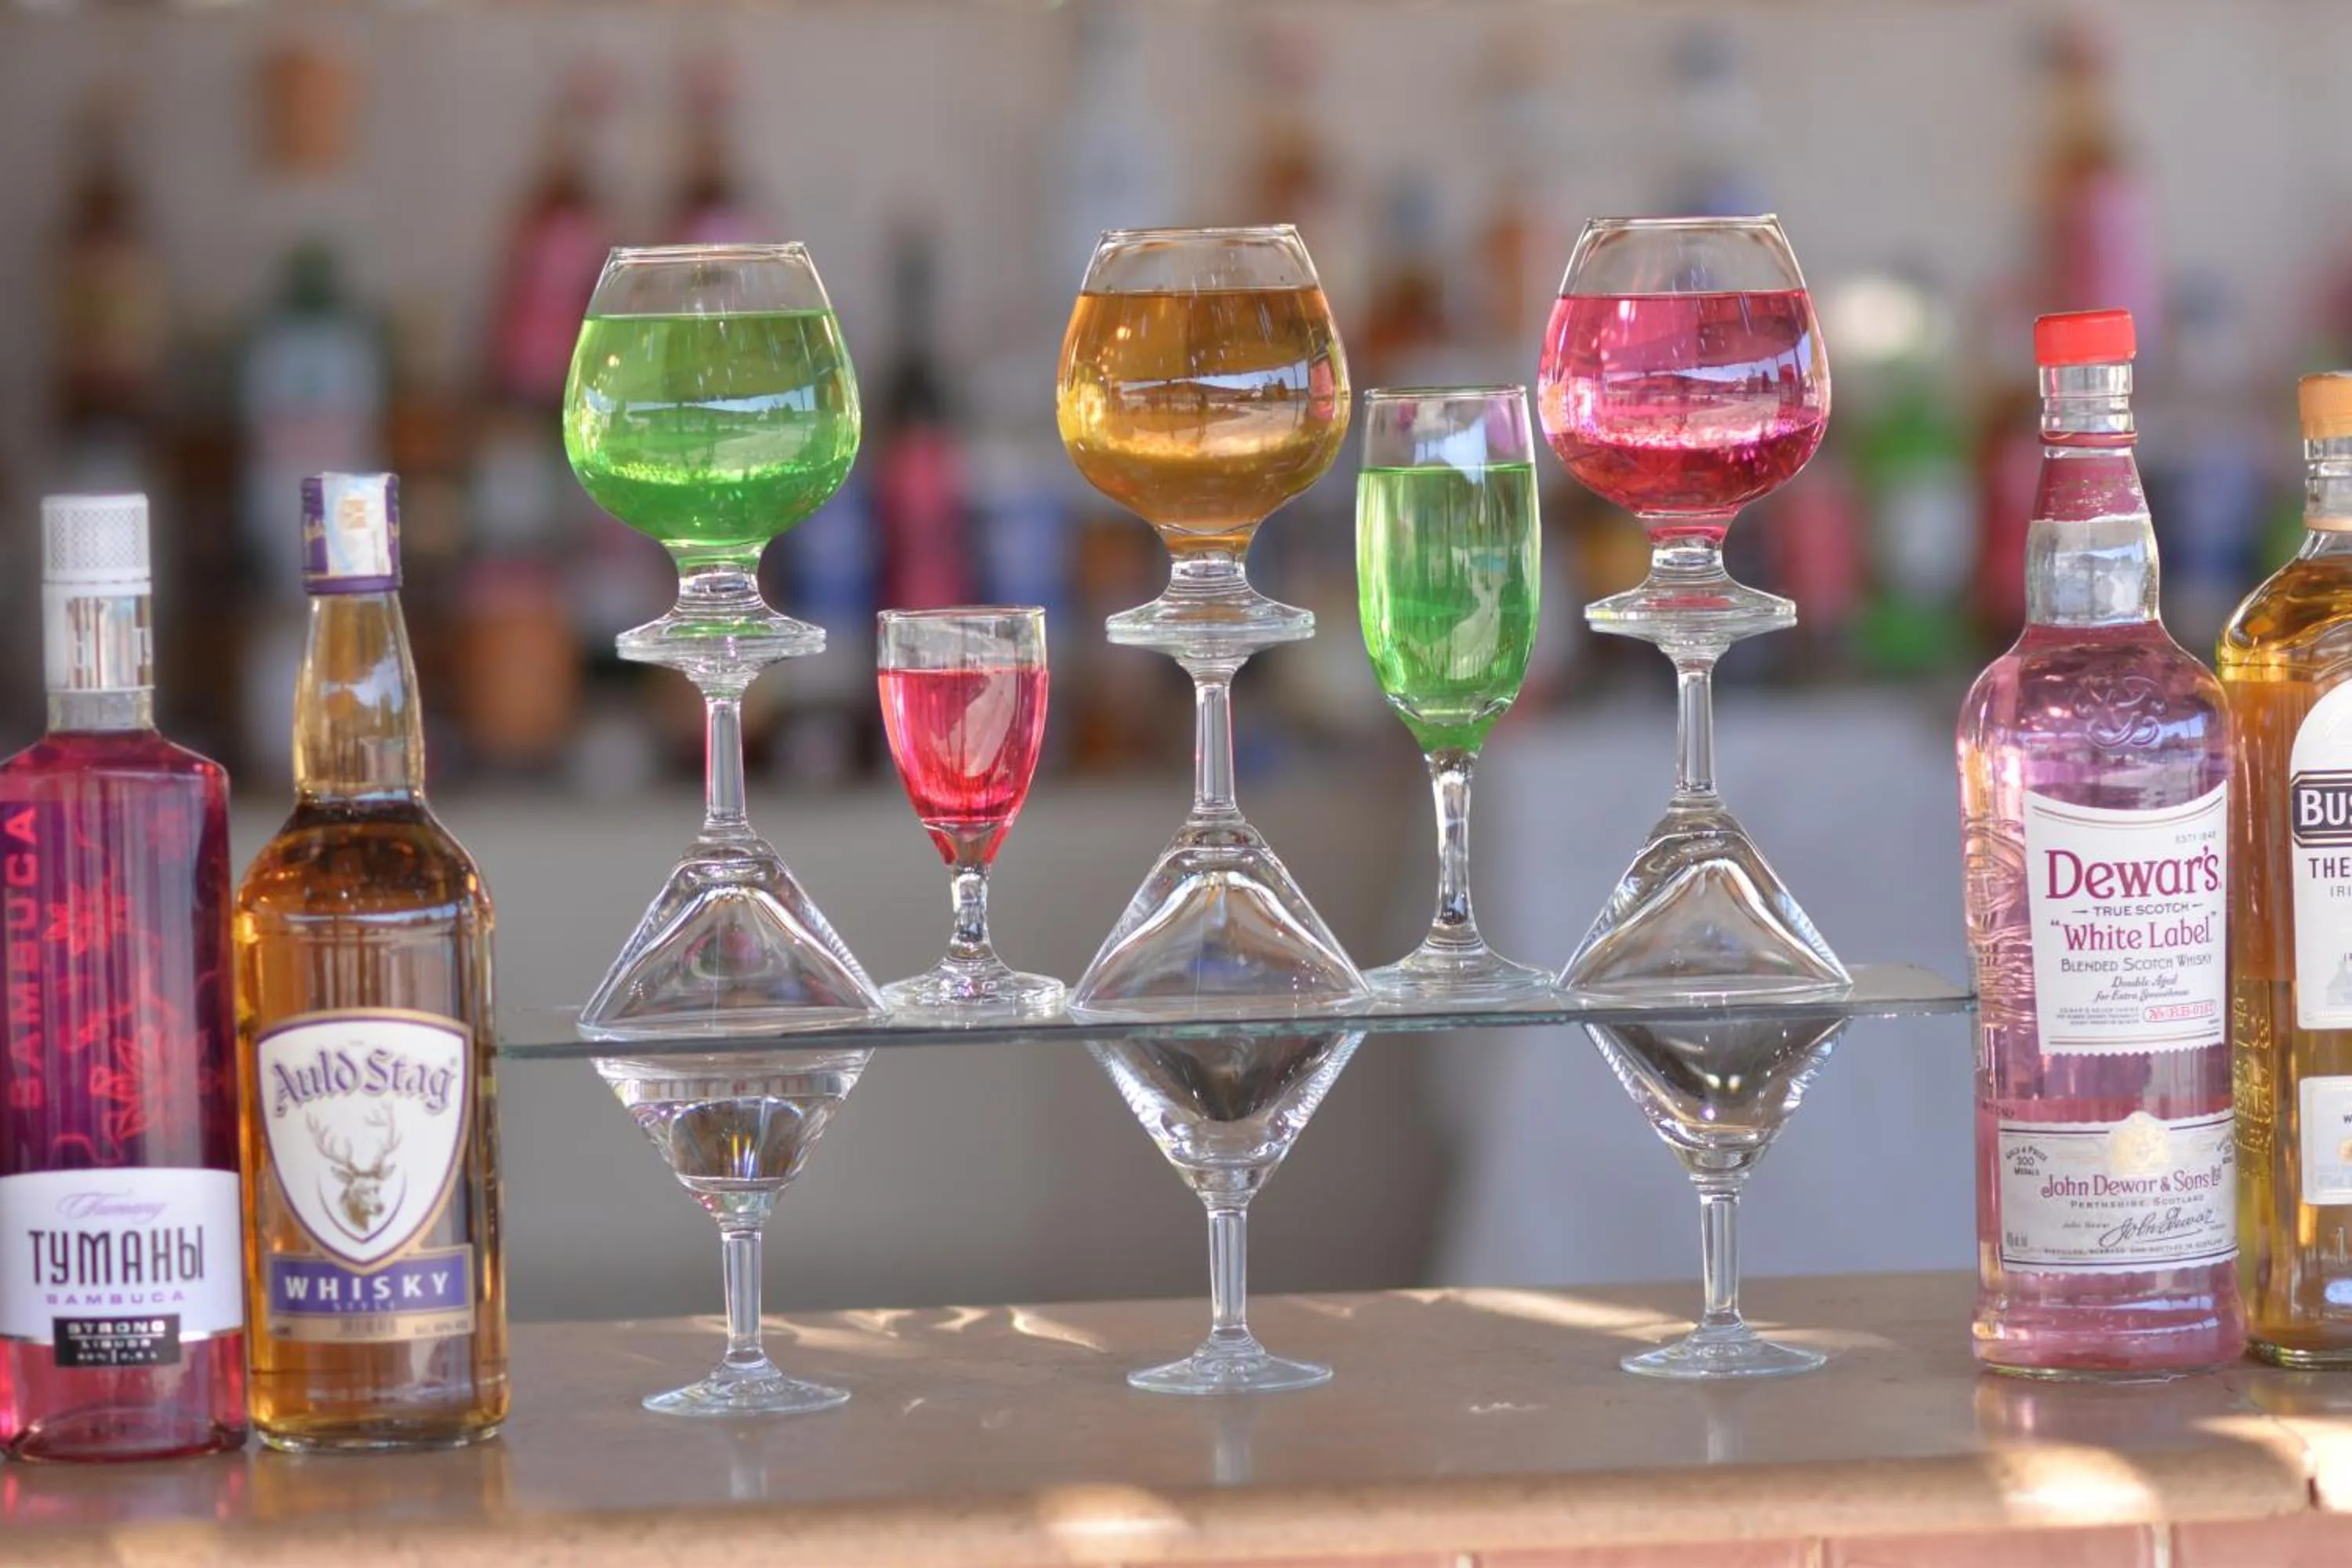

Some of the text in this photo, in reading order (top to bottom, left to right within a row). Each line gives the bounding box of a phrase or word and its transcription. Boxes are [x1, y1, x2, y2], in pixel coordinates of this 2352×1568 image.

[2299, 789, 2352, 826] BU
[2045, 844, 2220, 899] Dewar's
[2308, 857, 2352, 879] THE
[2093, 902, 2190, 916] TRUE SCOTCH
[5, 807, 43, 1109] SAMBUCA
[2061, 952, 2213, 973] BLENDED SCOTCH WHISKY
[271, 1047, 455, 1117] Auld Stag
[2041, 1174, 2089, 1199] John
[2093, 1174, 2158, 1196] Dewar
[2160, 1177, 2171, 1192] &
[2173, 1169, 2209, 1192] Sons
[28, 1225, 204, 1286] ТУМАНЫ
[46, 1290, 185, 1305] SAMBUCA
[285, 1272, 449, 1301] WHISKY
[67, 1319, 165, 1333] STRONG
